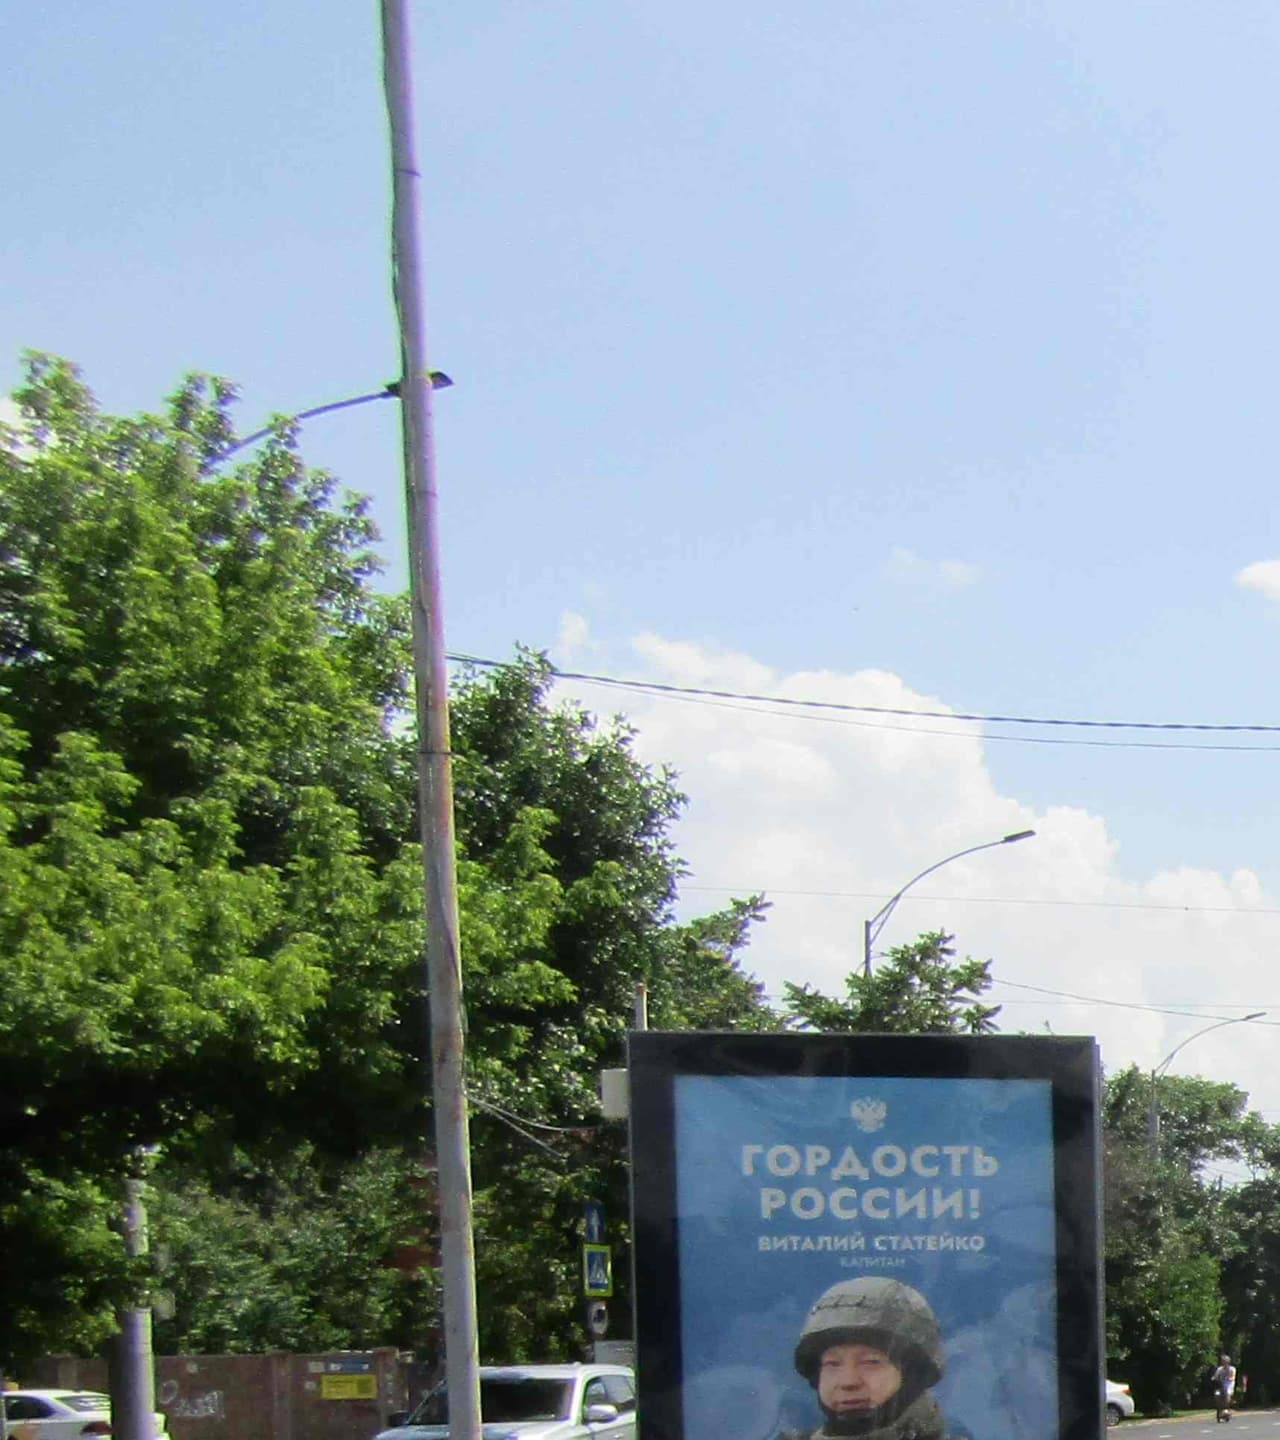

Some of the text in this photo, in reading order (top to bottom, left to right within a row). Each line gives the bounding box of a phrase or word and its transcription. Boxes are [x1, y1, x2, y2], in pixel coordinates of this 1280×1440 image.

[741, 1144, 1000, 1181] ГОРДОСТЬ
[760, 1187, 982, 1220] РОССИИ!
[758, 1231, 986, 1251] ВИТАЛИЙ СТАТЕЙКО
